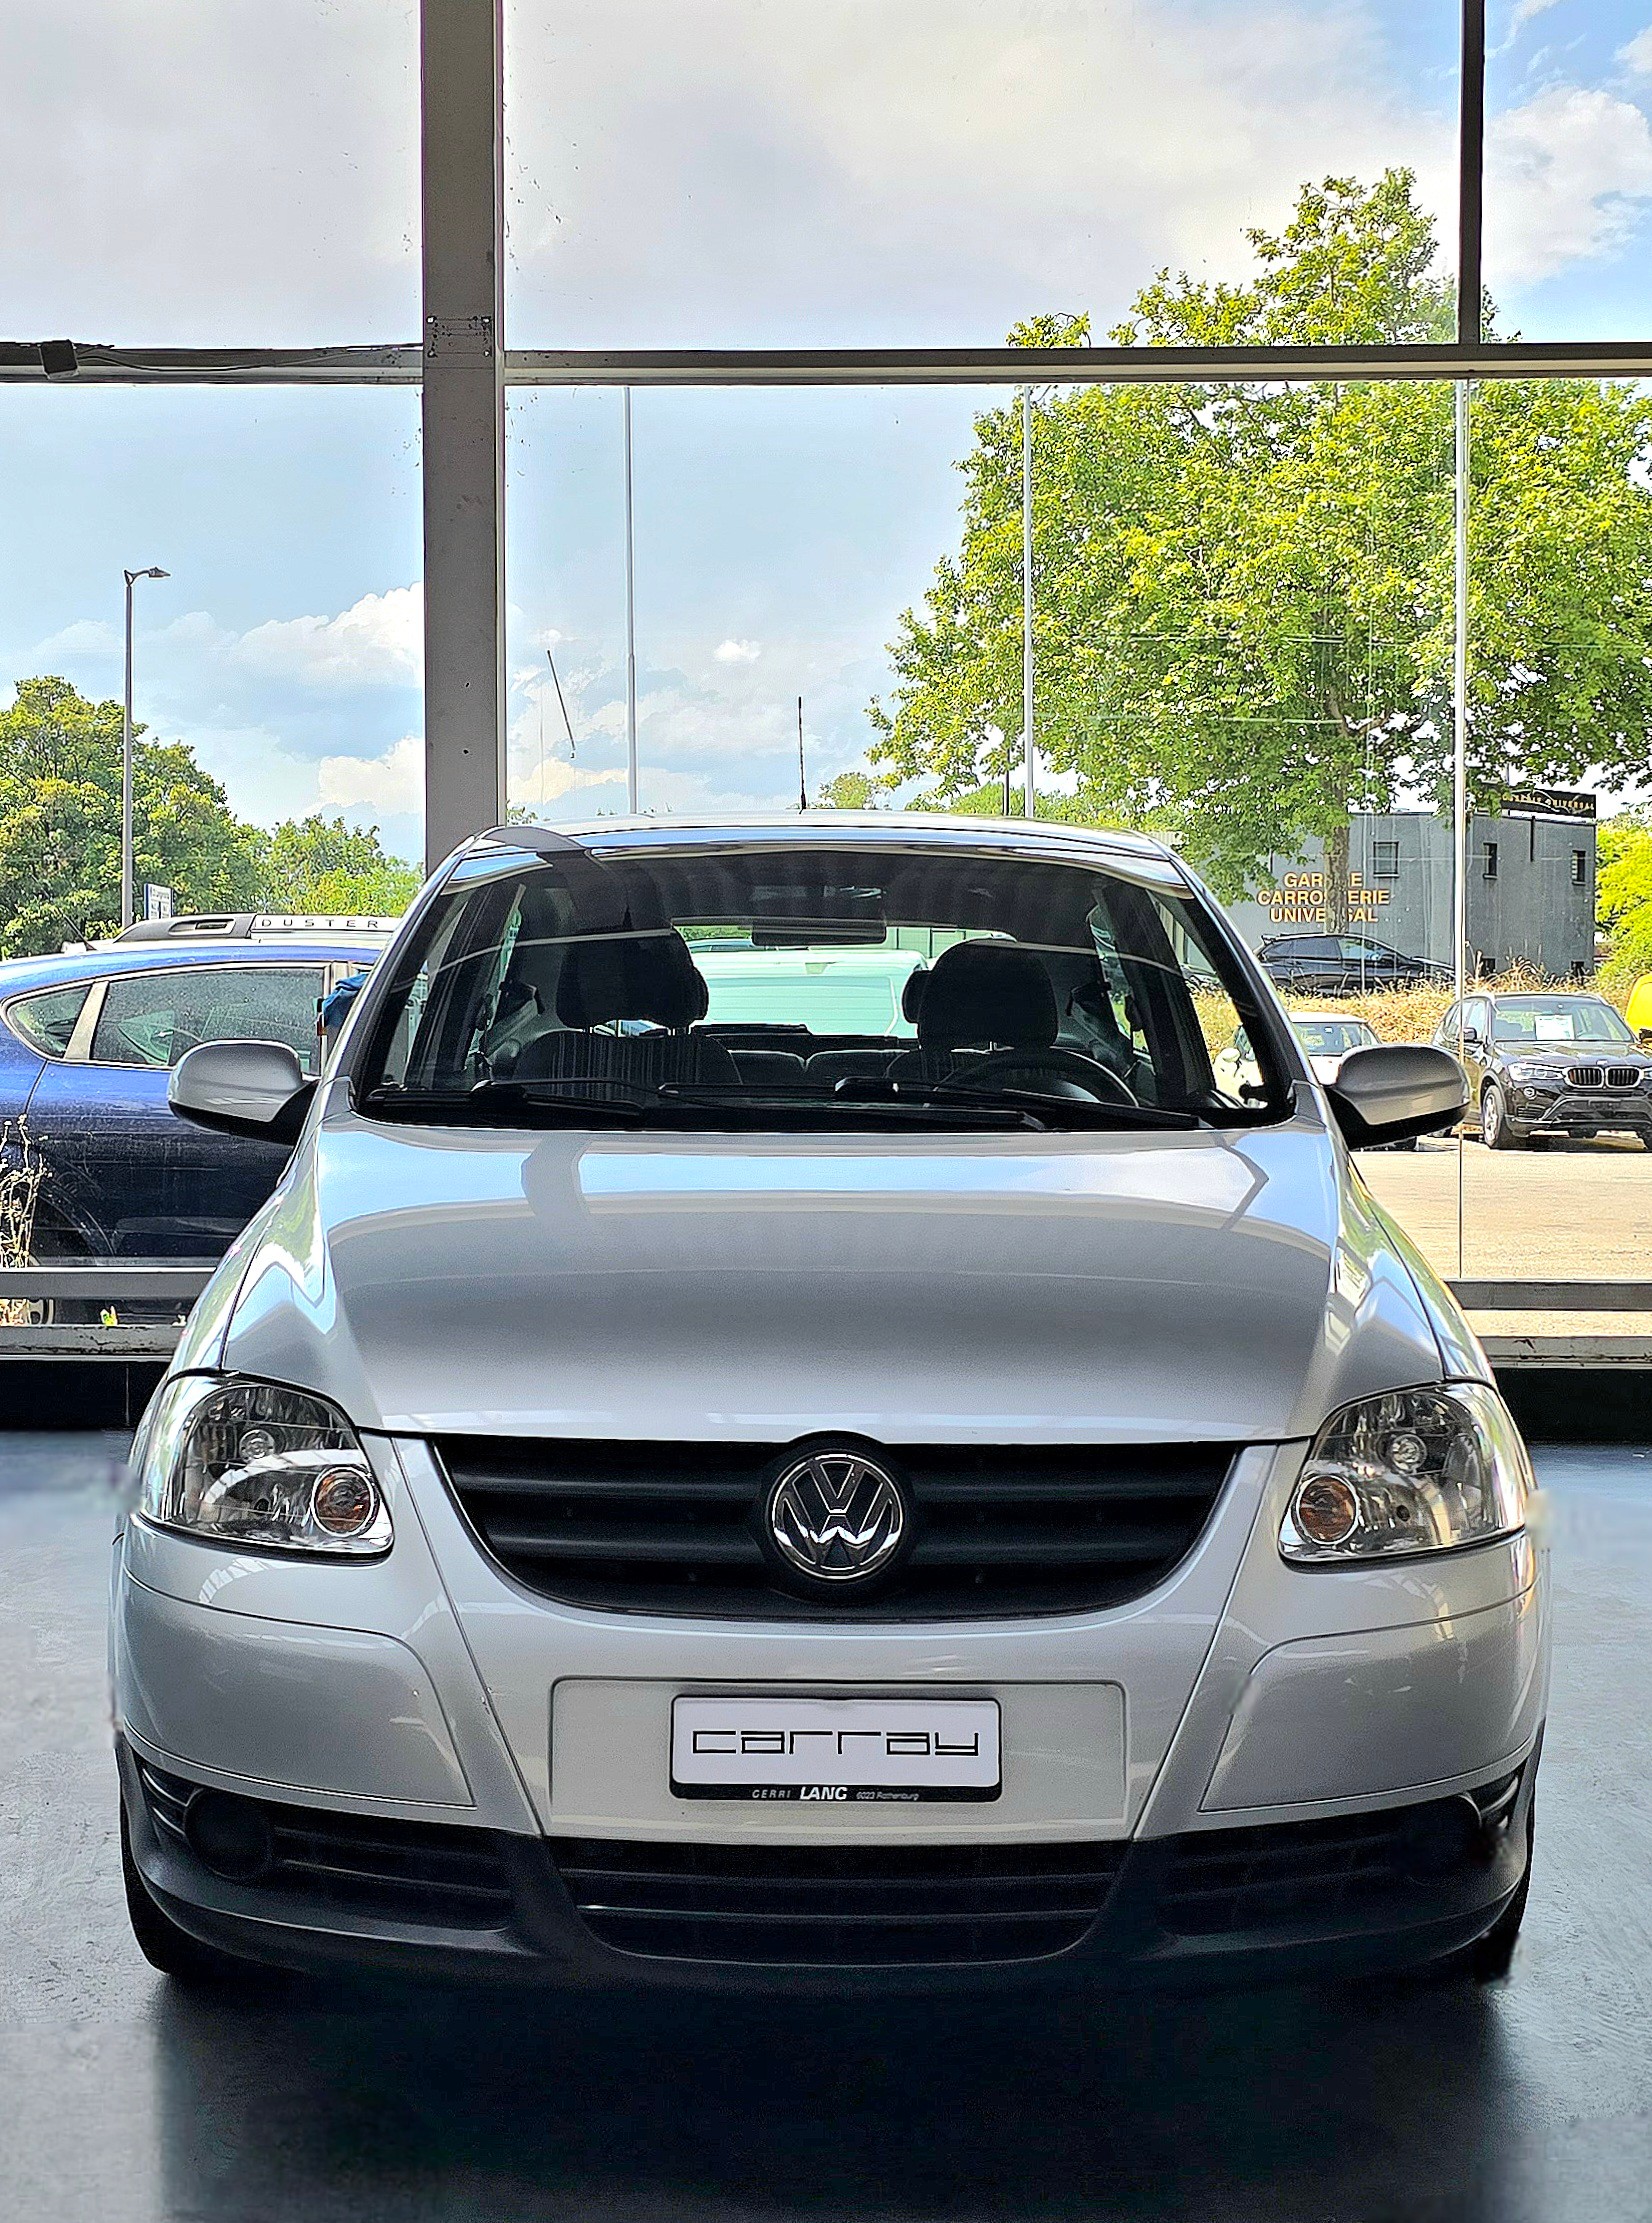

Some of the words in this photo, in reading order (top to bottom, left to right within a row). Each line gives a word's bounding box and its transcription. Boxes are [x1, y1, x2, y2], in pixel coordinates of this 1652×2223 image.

[1284, 872, 1363, 888] GARE
[1257, 890, 1390, 905] CARROERIE
[1270, 908, 1379, 923] UNIVEAL
[261, 919, 379, 928] DUSTER
[693, 1730, 979, 1756] carray
[800, 1786, 848, 1800] LANG
